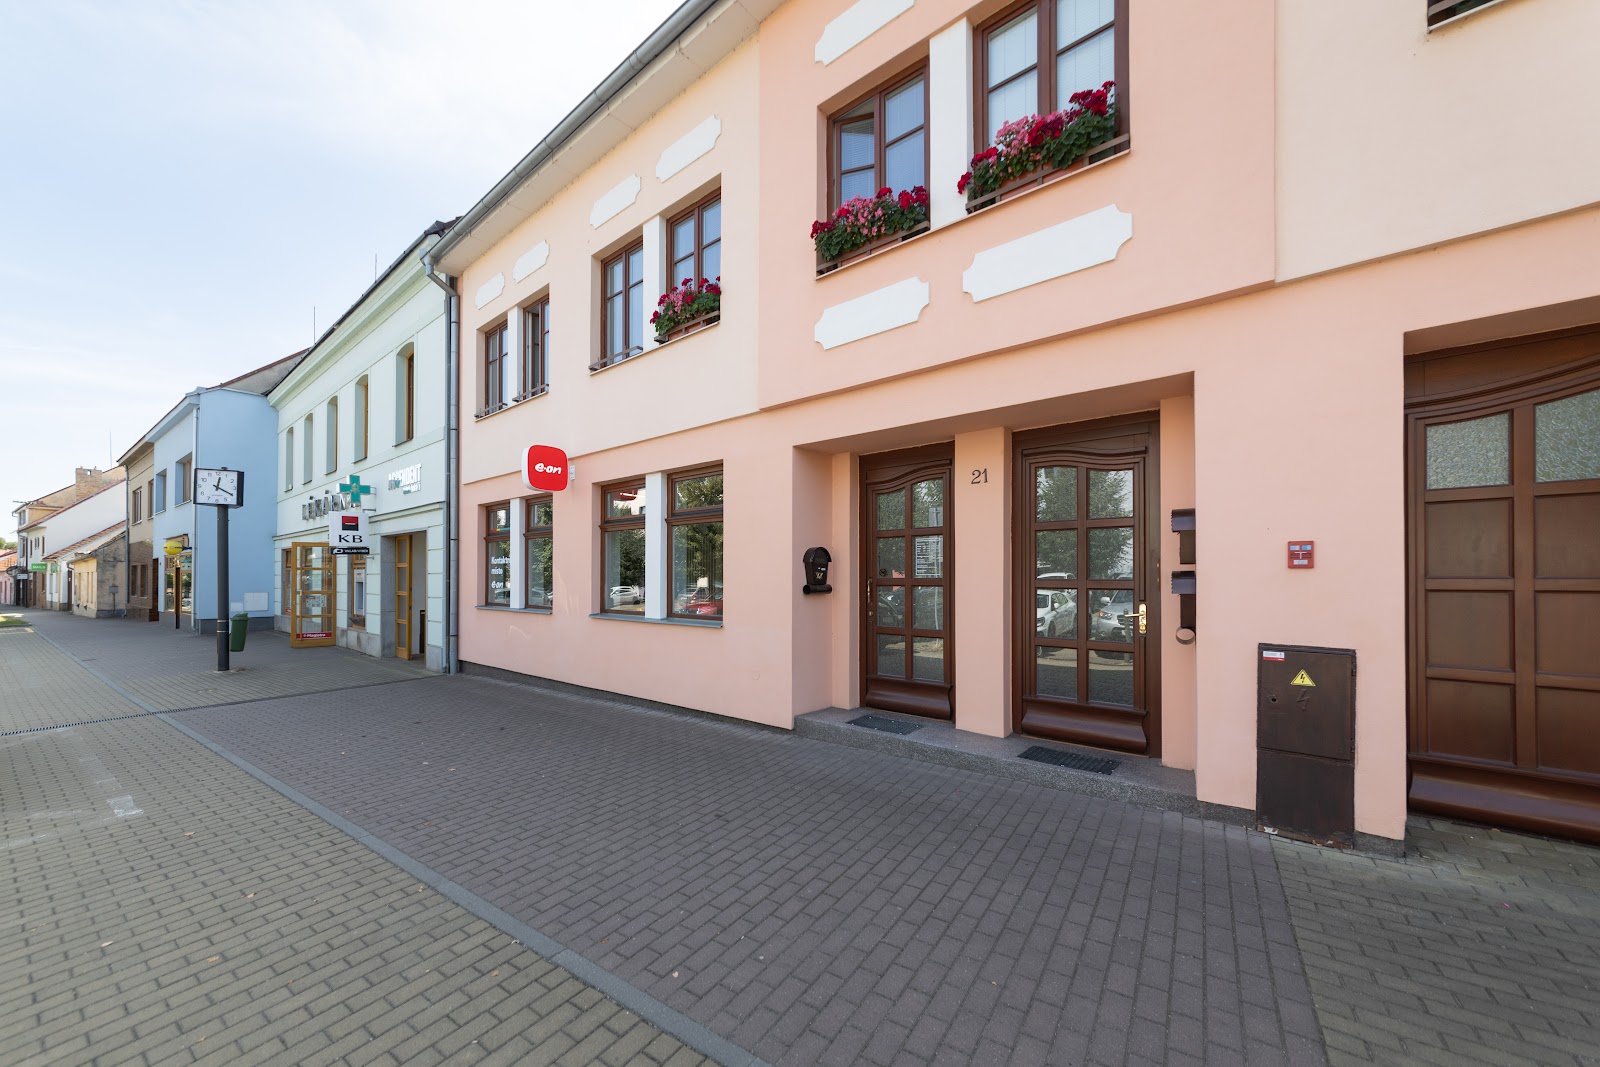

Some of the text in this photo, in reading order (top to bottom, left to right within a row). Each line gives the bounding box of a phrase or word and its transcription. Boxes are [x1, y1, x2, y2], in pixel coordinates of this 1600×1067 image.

[971, 468, 988, 484] 21
[302, 490, 361, 520] LÉKÁRN
[338, 534, 363, 543] KB
[491, 556, 510, 564] Kontaktn
